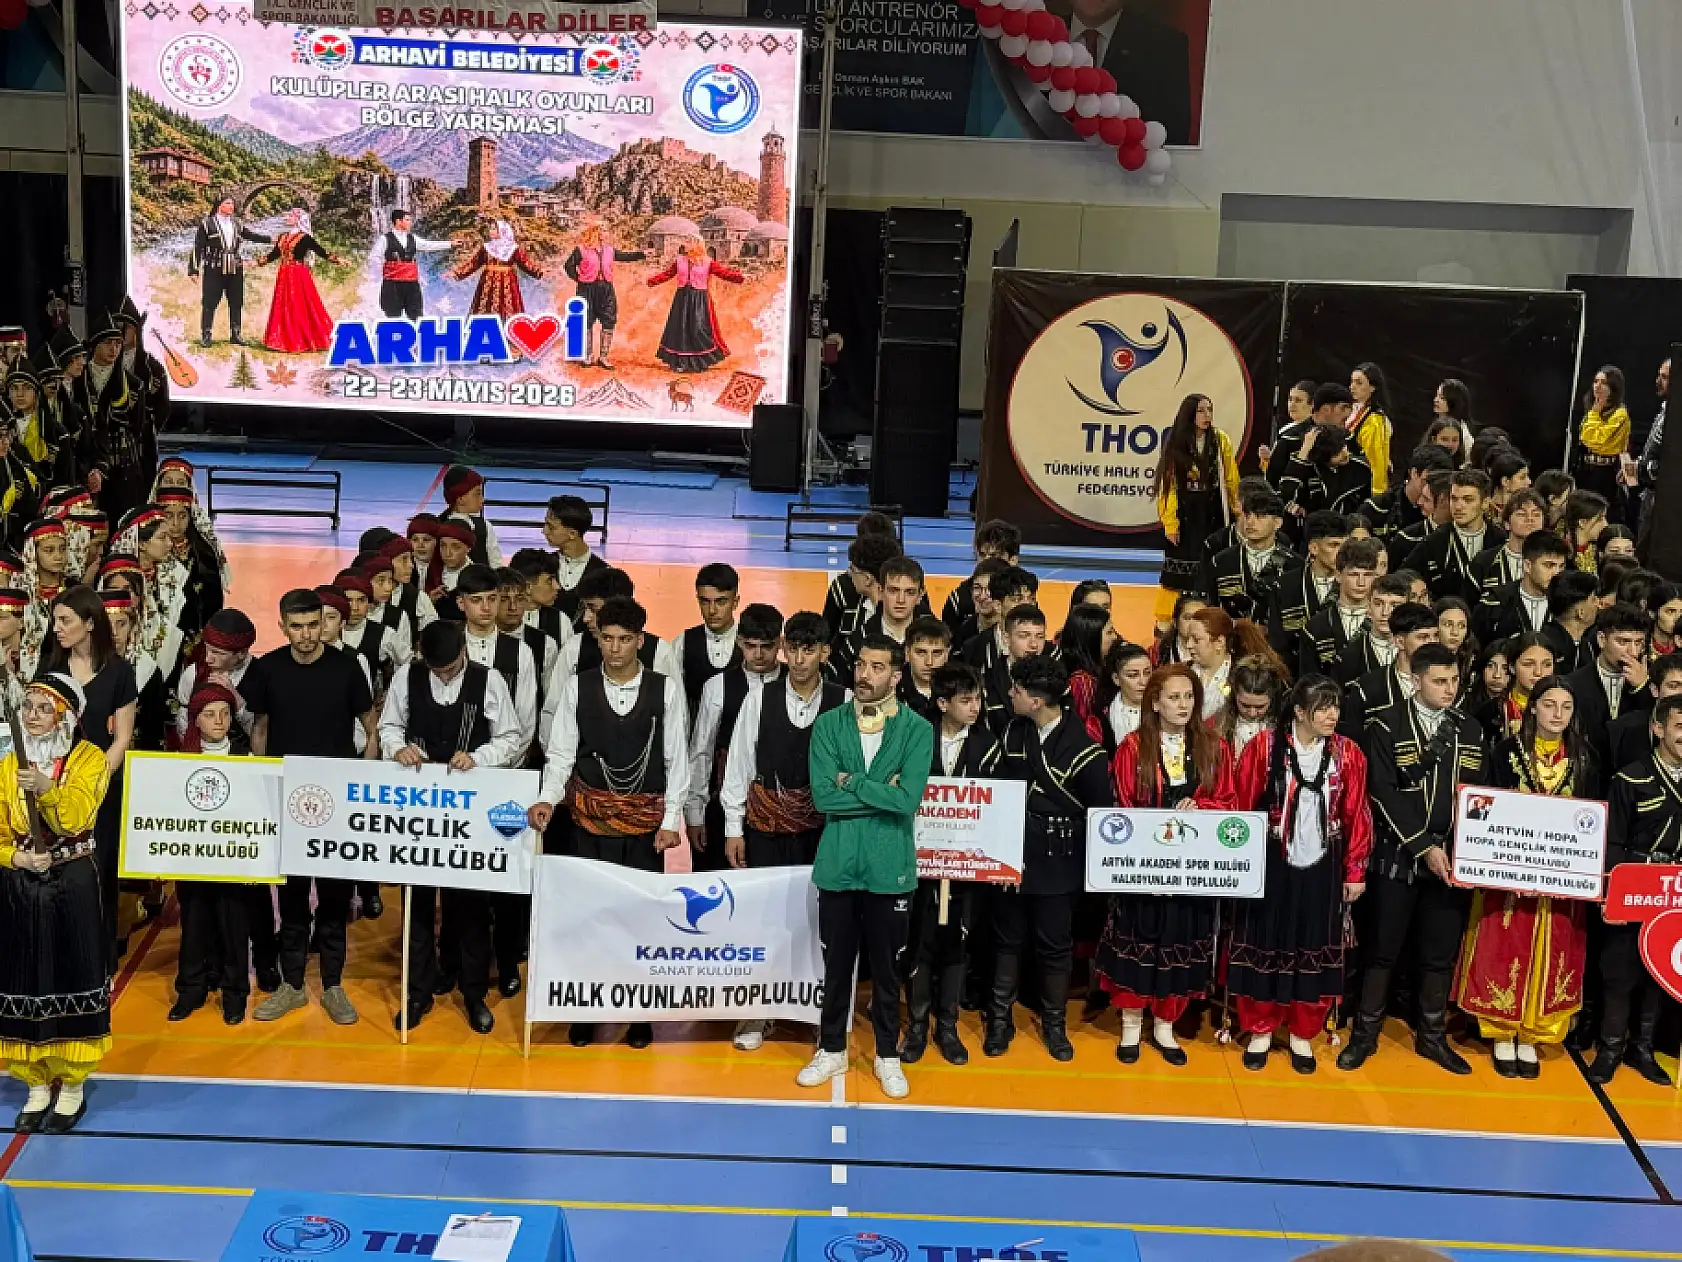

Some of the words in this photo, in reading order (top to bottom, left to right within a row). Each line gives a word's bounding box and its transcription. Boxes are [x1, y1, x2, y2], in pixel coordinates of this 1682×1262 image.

[261, 11, 291, 20] SPOR
[295, 12, 360, 24] BAKANLIĞI
[557, 9, 648, 31] DİLER
[848, 1, 957, 20] ANTRENÖR
[882, 36, 967, 56] DİLİYORUM
[358, 43, 446, 66] ARHAVİ
[452, 48, 575, 73] BELEDİYESİ
[270, 75, 390, 101] KULÜPLER
[393, 83, 467, 105] ARASI
[469, 86, 532, 109] HALK
[536, 91, 654, 114] OYUNLARI
[857, 86, 873, 97] VE
[875, 87, 908, 99] SPOR
[361, 102, 436, 128] BÖLGE
[440, 110, 567, 138] YARIŞMASI
[427, 377, 506, 403] MAYIS
[509, 383, 577, 406] 2026
[1043, 460, 1100, 478] TÜRKİYE
[1103, 464, 1141, 479] HALK
[1077, 483, 1156, 498] FEDERASYO
[346, 781, 478, 812] ELEŞKİRT
[922, 779, 993, 805] RTVİN
[916, 804, 982, 821] AKADEMİ
[133, 816, 208, 834] BAYBURT
[211, 818, 278, 840] GENÇLİK
[347, 811, 472, 842] GENÇLİK
[1487, 823, 1534, 839] ARTVİN
[1543, 830, 1578, 844] HOPA
[148, 842, 191, 857] SPOR
[194, 840, 259, 860] KULÜBÜ
[306, 838, 380, 863] SPOR
[389, 843, 509, 873] KULÜBÜ
[1466, 834, 1495, 847] HOPA
[1498, 839, 1546, 853] GENÇLİK
[1550, 846, 1598, 860] MERKEZİ
[1491, 851, 1521, 863] SPOR
[1101, 853, 1136, 867] ARTVİN
[1139, 856, 1181, 869] AKADEMİ
[1184, 858, 1210, 870] SPOR
[1213, 858, 1251, 872] KULÜBÜ
[1111, 873, 1182, 886] HALKOYUNLARI
[1186, 875, 1239, 888] TOPLULUĞU
[1459, 865, 1486, 877] HALK
[1488, 869, 1537, 883] OYUNLARI
[1540, 874, 1597, 891] TOPLULUĞU
[1623, 891, 1669, 907] BRAGİ
[635, 943, 766, 962] KARAKÖSE
[648, 964, 694, 977] SANAT
[696, 964, 754, 977] KULÜBÜ
[548, 980, 604, 1008] HALK
[610, 982, 715, 1009] OYUNLARI
[722, 977, 825, 1008] TOPLULUĞ
[362, 1230, 438, 1256] TH
